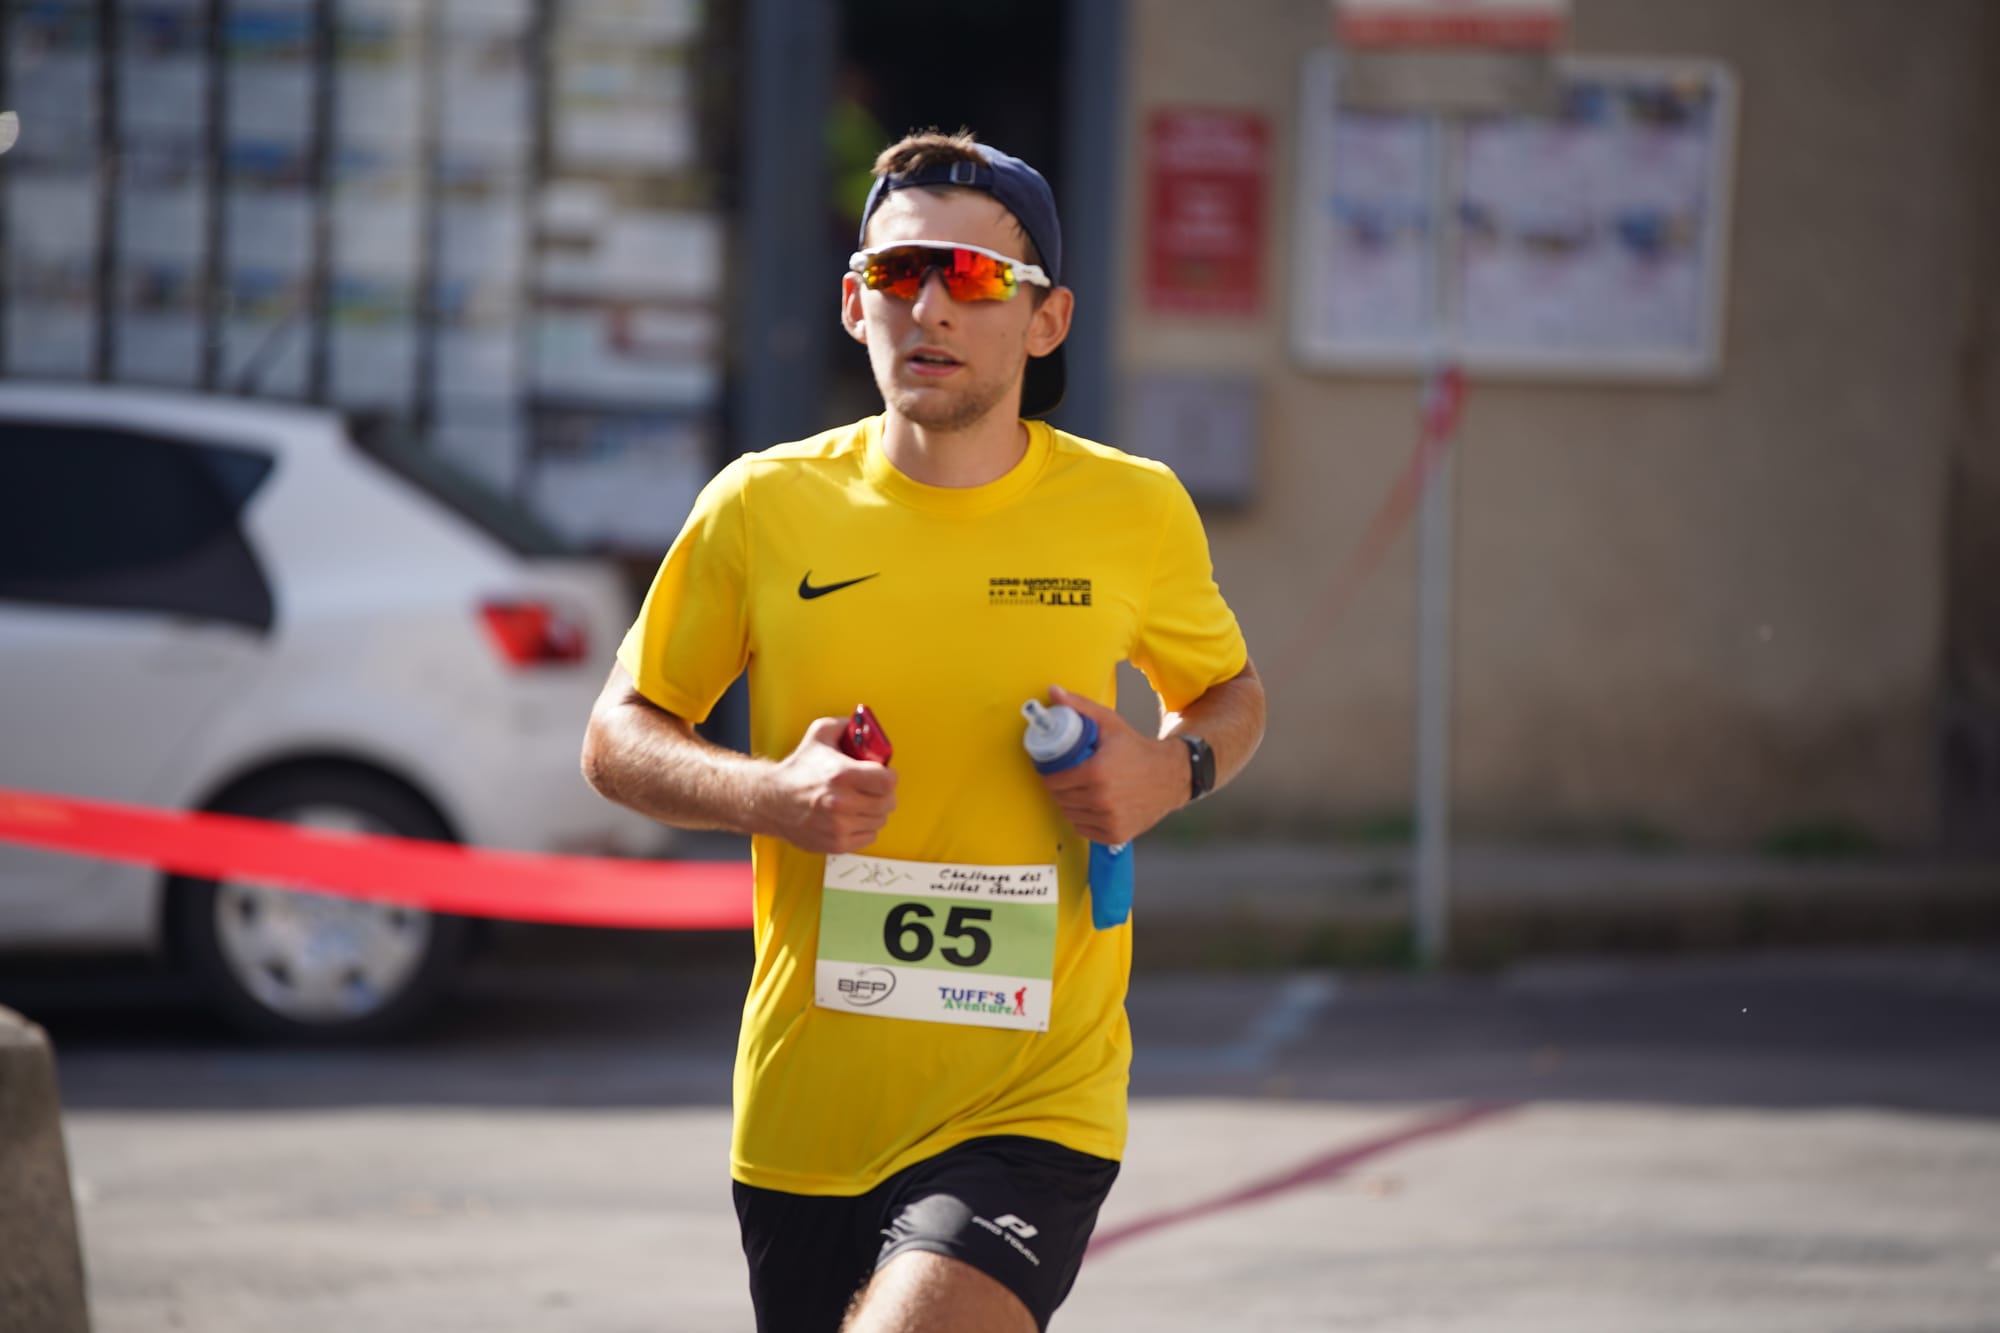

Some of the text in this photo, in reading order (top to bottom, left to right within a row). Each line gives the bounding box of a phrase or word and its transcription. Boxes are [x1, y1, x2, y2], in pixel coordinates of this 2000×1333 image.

[939, 868, 1041, 888] Challenge des
[883, 902, 992, 967] 65
[838, 979, 887, 994] BFP
[938, 987, 1006, 1005] TUFF'S
